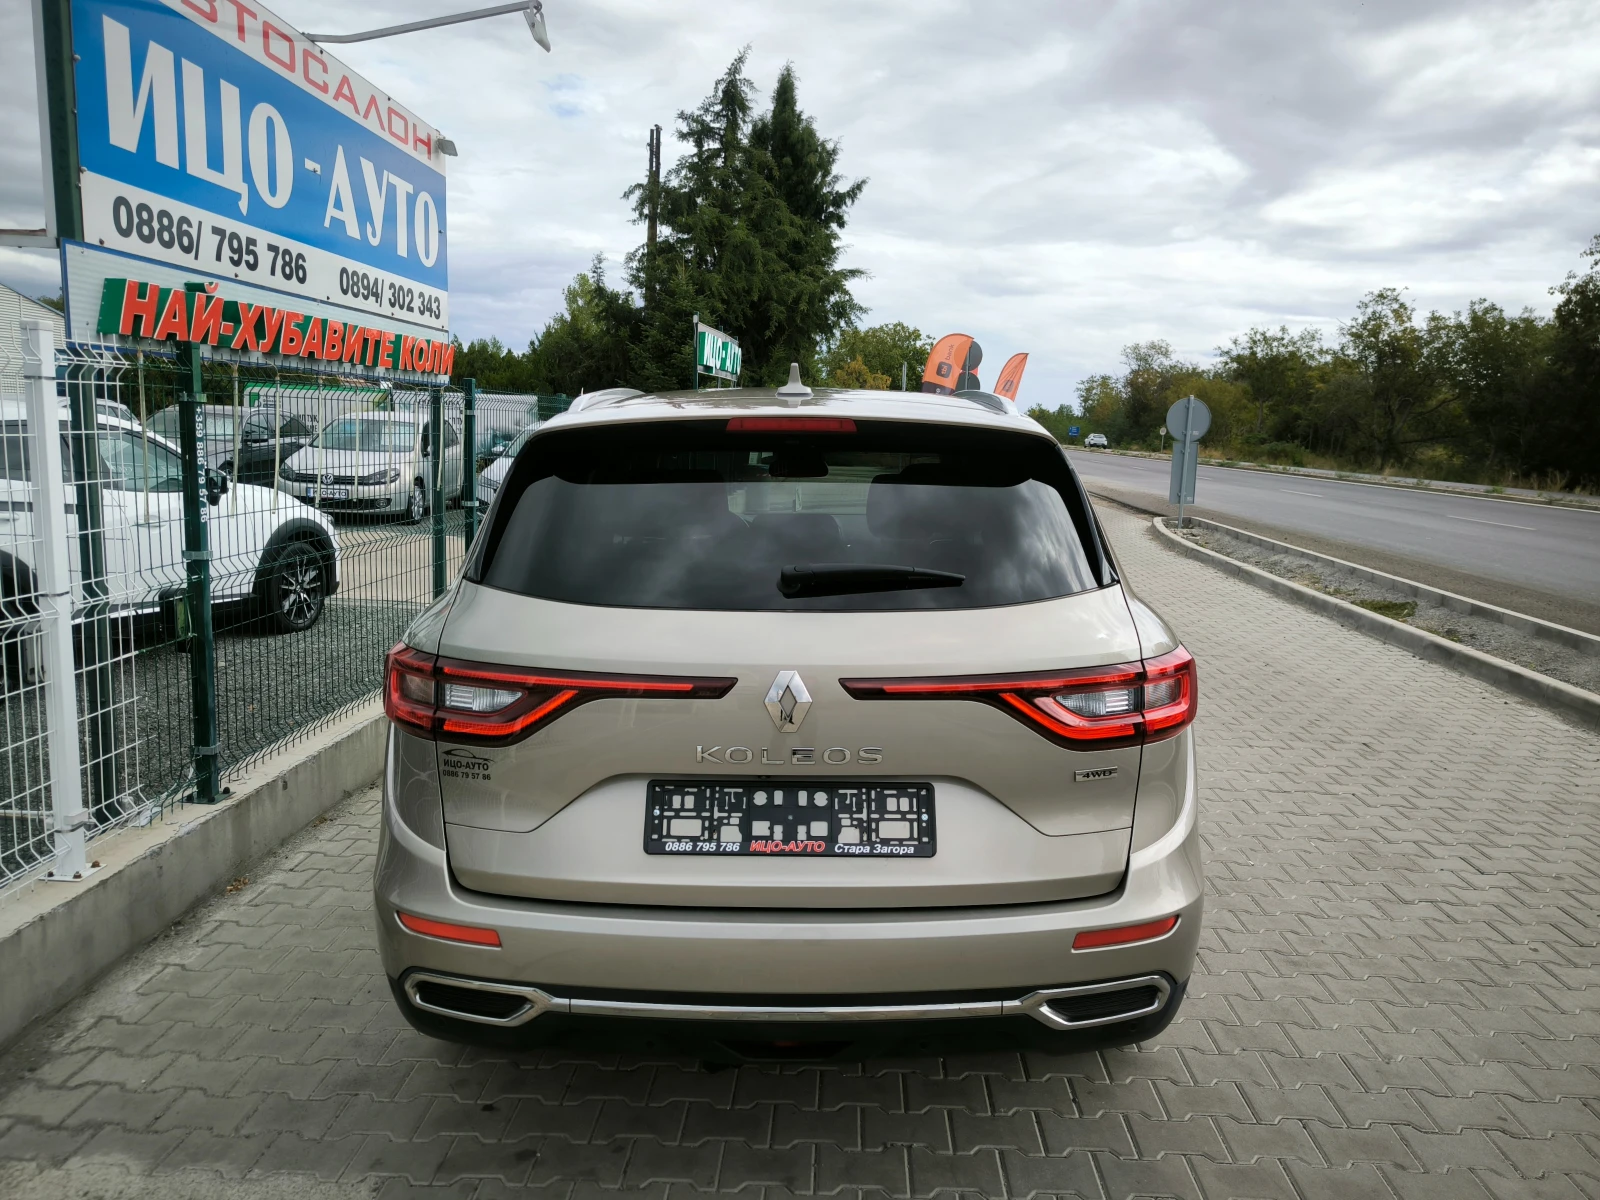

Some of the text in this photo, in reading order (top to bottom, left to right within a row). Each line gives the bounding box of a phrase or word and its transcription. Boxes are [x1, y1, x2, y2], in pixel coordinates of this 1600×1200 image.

[113, 196, 307, 284] 0886/ 795 786
[340, 266, 441, 320] 0894/ 302 343
[118, 280, 455, 376] НАЙ-ХУБАВИТЕ КОЛИ
[196, 441, 205, 465] 886
[197, 468, 206, 484] 79
[200, 507, 208, 522] 86
[696, 745, 883, 765] KOLEOS
[443, 759, 489, 770] ИЦО-АУТО
[461, 771, 470, 779] 79
[471, 772, 480, 780] 57
[482, 773, 491, 781] 86
[1082, 770, 1112, 779] 4WD
[665, 842, 740, 852] 0886 795 786
[749, 840, 826, 853] ИЦО-АУТО
[834, 843, 915, 855] Стара Загора
